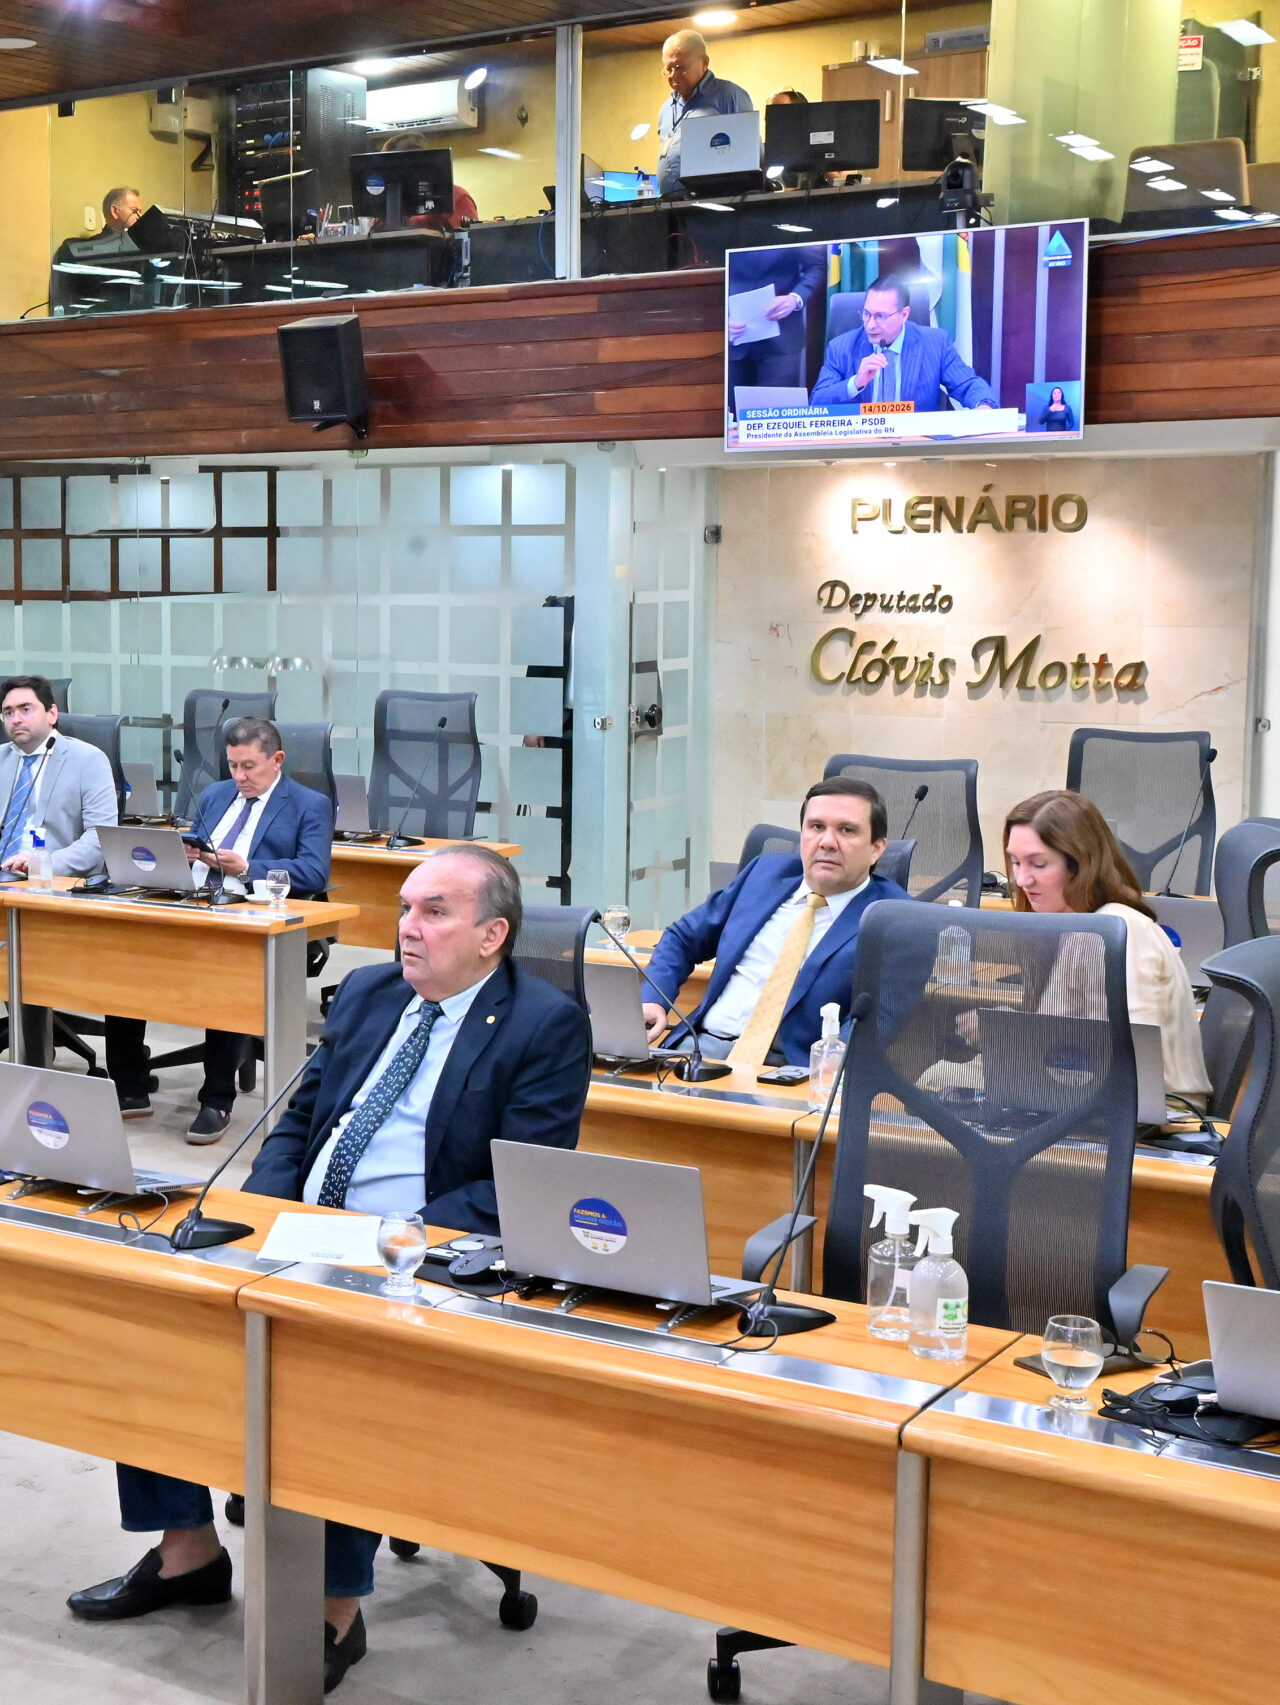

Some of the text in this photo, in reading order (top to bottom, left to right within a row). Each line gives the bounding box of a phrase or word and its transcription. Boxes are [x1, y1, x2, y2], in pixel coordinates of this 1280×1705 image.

[746, 405, 829, 418] SESSÃO ORDINÁRIA
[862, 403, 912, 413] 14/10/2026
[746, 422, 764, 431] DEP.
[766, 421, 807, 430] EZEQUIEL
[809, 419, 853, 428] FERREIRA
[861, 417, 886, 426] PSDB
[794, 429, 833, 437] Assembleia
[834, 428, 872, 436] Legislativa
[850, 483, 1088, 534] PLENÁRIO
[817, 579, 954, 620] Deputado
[810, 627, 1148, 691] Clóvis Motta
[573, 1208, 601, 1218] FAZEMOS
